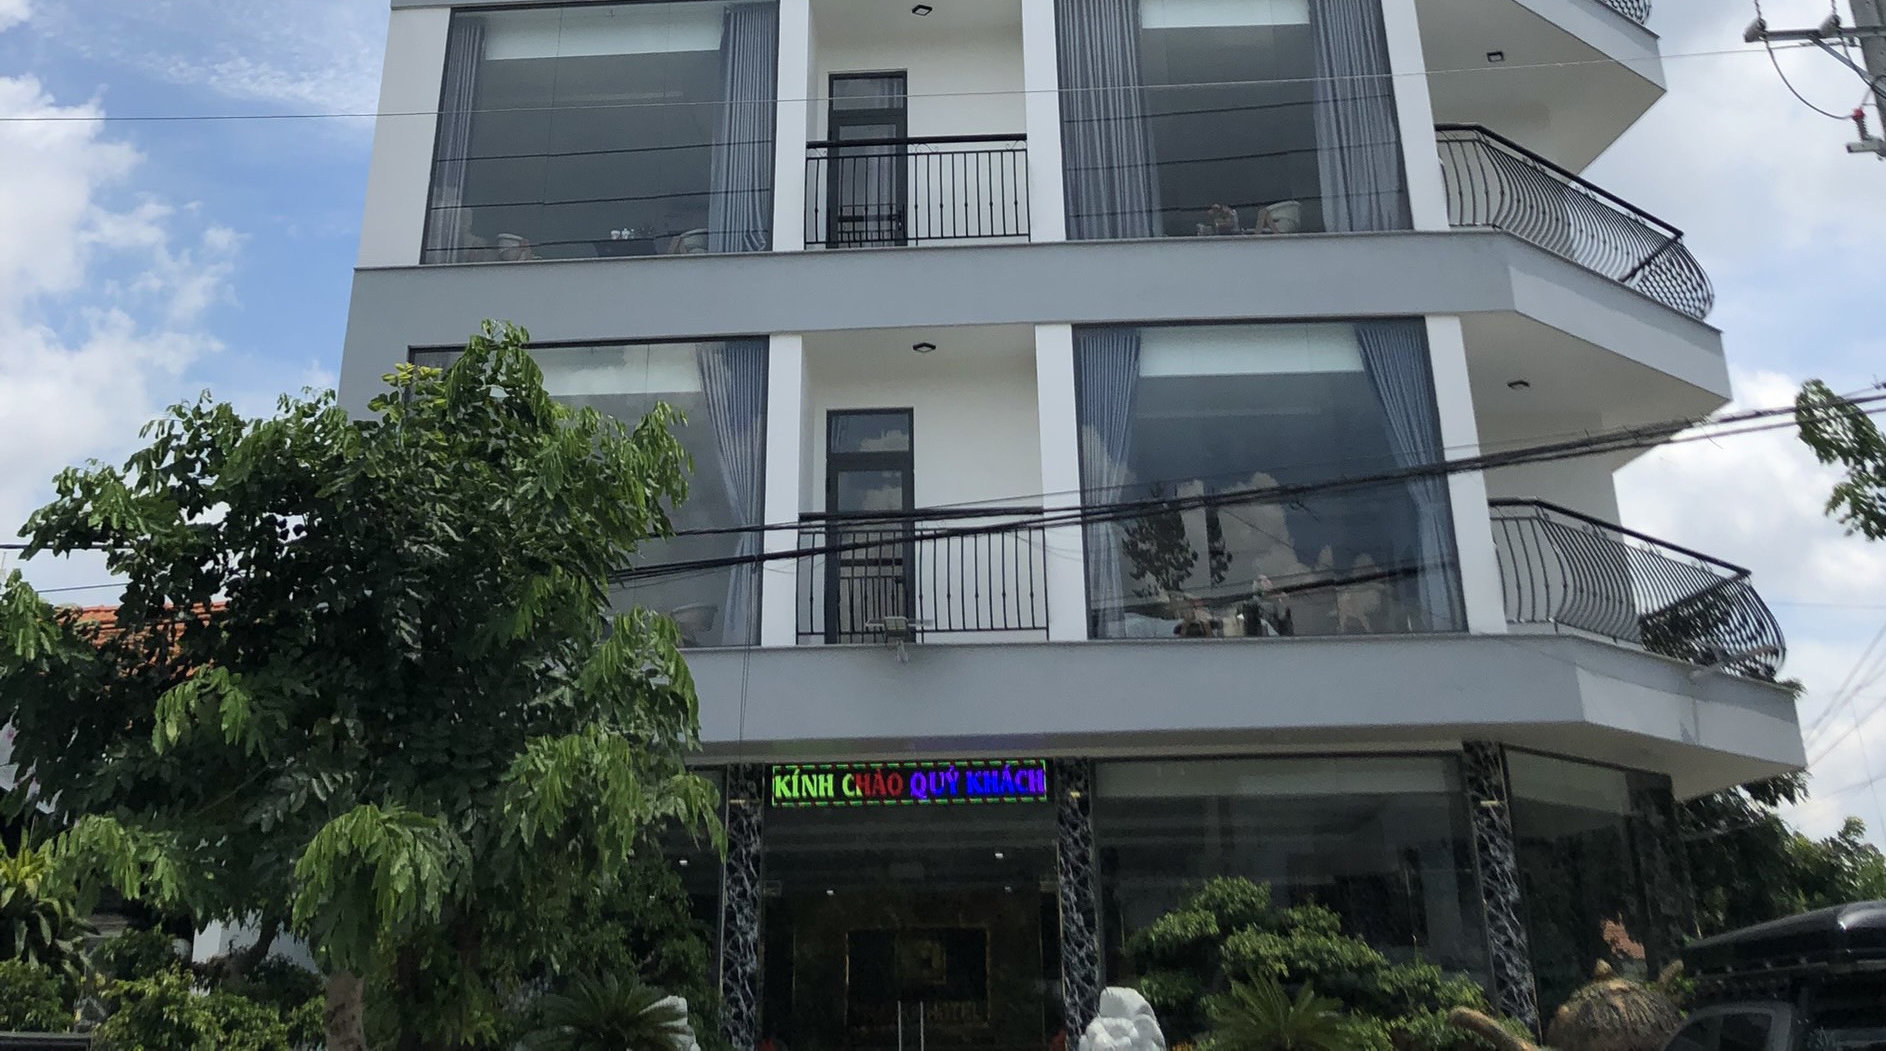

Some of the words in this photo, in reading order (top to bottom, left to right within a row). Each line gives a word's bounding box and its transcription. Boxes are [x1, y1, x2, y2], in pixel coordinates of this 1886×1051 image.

[775, 768, 834, 798] KÍNH
[842, 767, 904, 797] CHÀO
[965, 764, 1045, 795] KHÁCH
